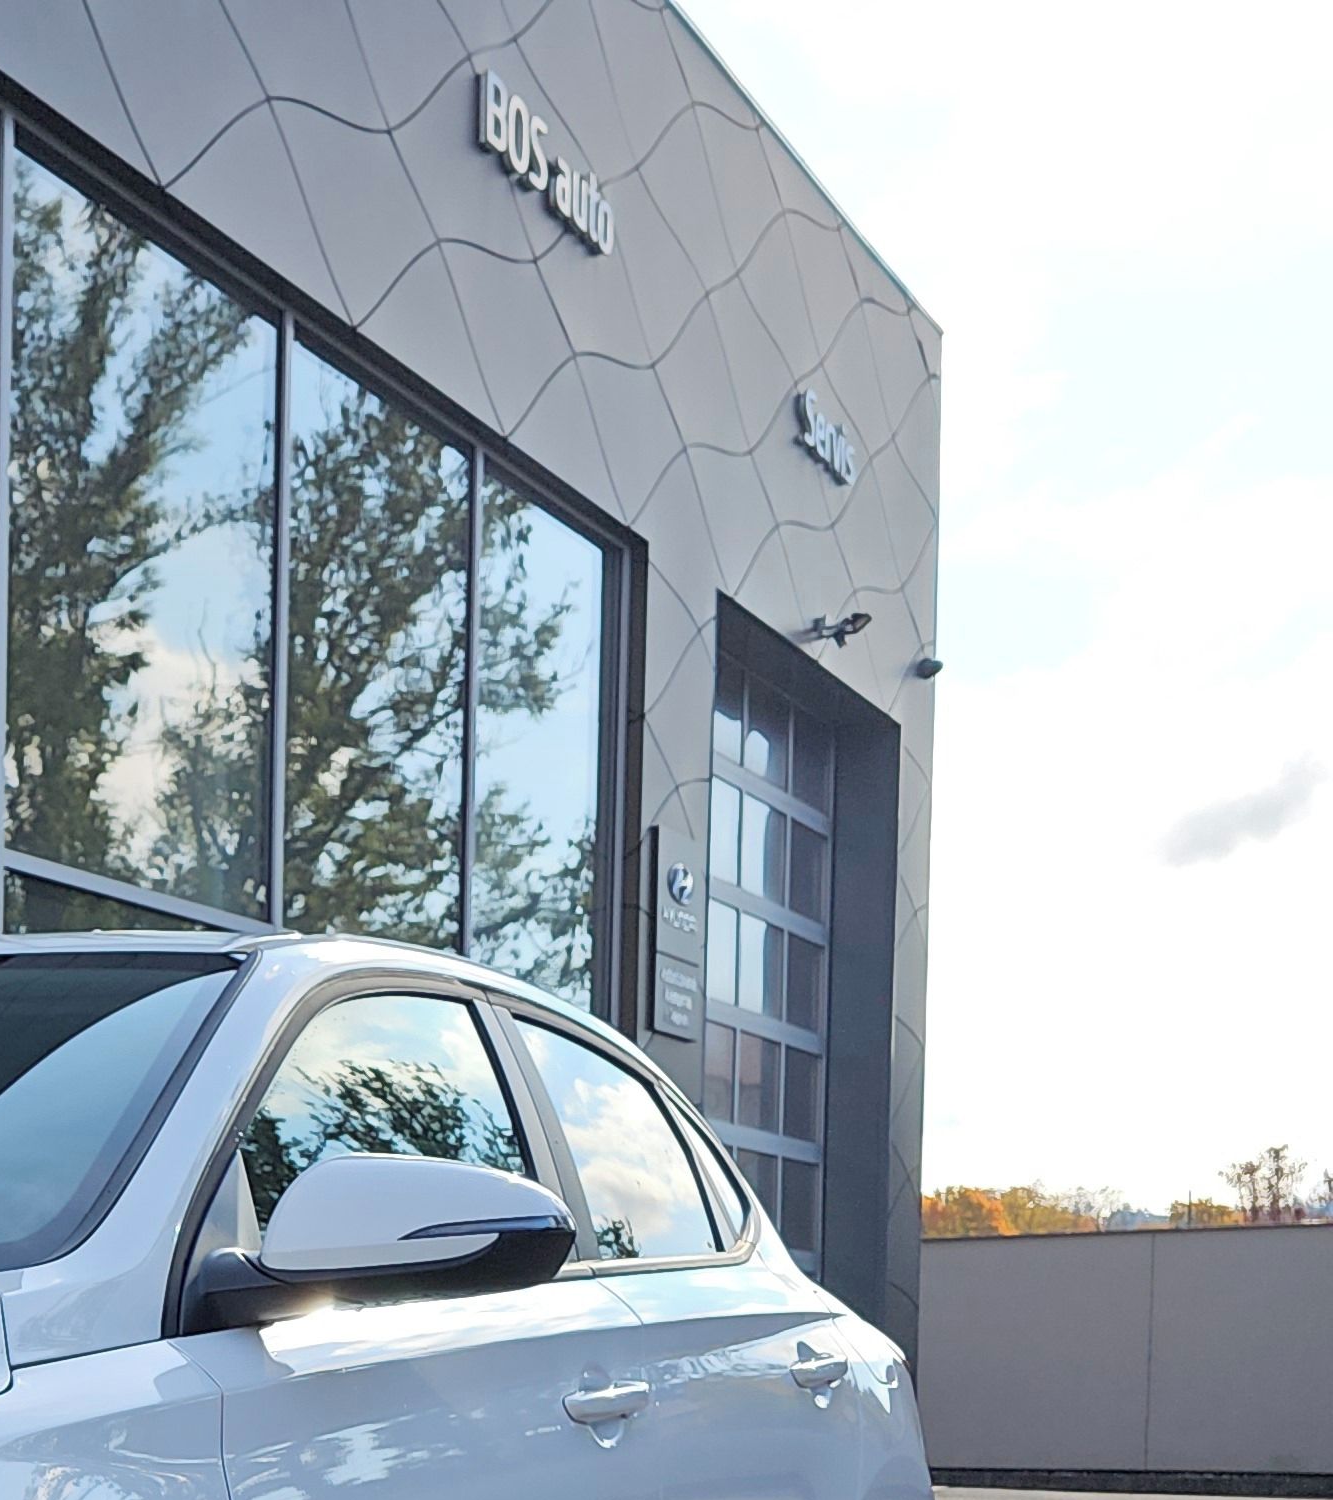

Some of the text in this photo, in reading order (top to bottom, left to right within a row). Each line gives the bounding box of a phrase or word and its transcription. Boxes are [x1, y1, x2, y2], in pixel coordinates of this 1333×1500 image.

[478, 69, 616, 256] BOS auto
[798, 388, 857, 487] Servis
